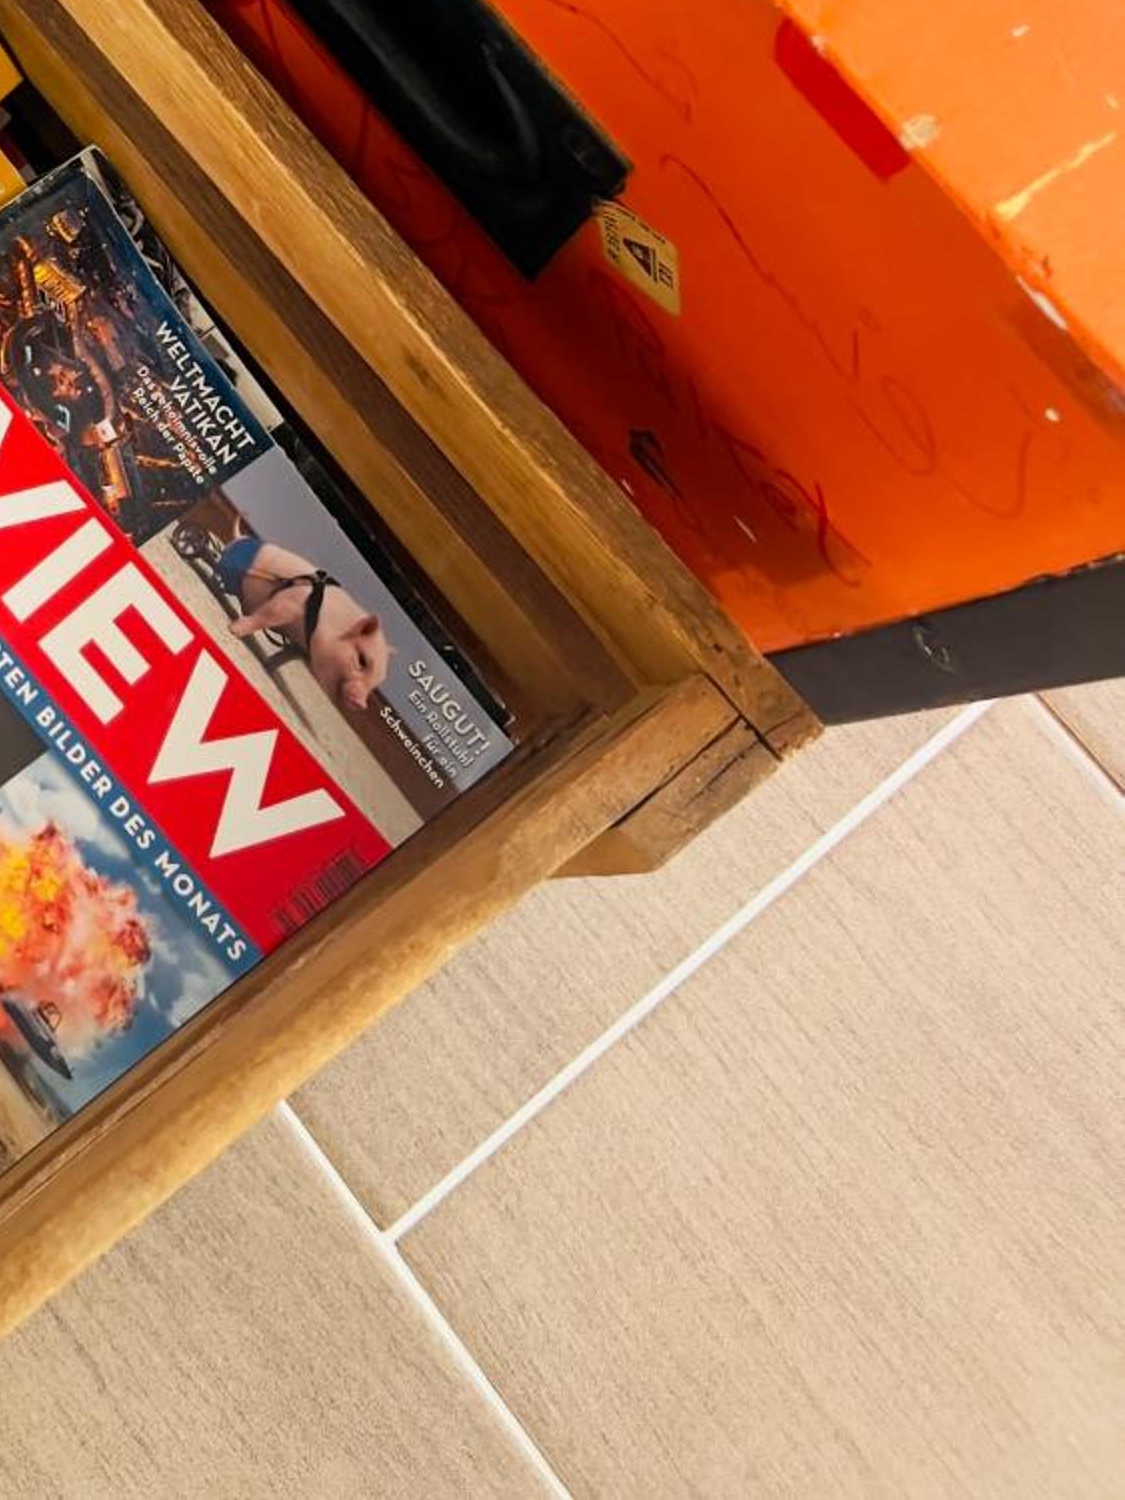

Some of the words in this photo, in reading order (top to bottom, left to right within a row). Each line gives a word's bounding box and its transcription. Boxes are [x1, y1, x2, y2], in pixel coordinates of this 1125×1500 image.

[130, 384, 162, 423] Reich
[156, 419, 176, 444] der
[170, 440, 206, 486] Päpste
[134, 363, 158, 391] Das
[148, 387, 219, 476] geheimnisvolle
[153, 319, 257, 450] WELTMACHT
[168, 374, 238, 466] VATIKAN
[377, 703, 446, 790] Schweinchen
[404, 655, 492, 757] SAUGUT!
[406, 688, 429, 714] Ein
[424, 710, 473, 769] Rollstuhl
[420, 731, 443, 757] für
[437, 754, 458, 778] ein
[32, 704, 118, 801] BILDER
[105, 793, 160, 853] DES
[149, 847, 252, 964] MONATS
